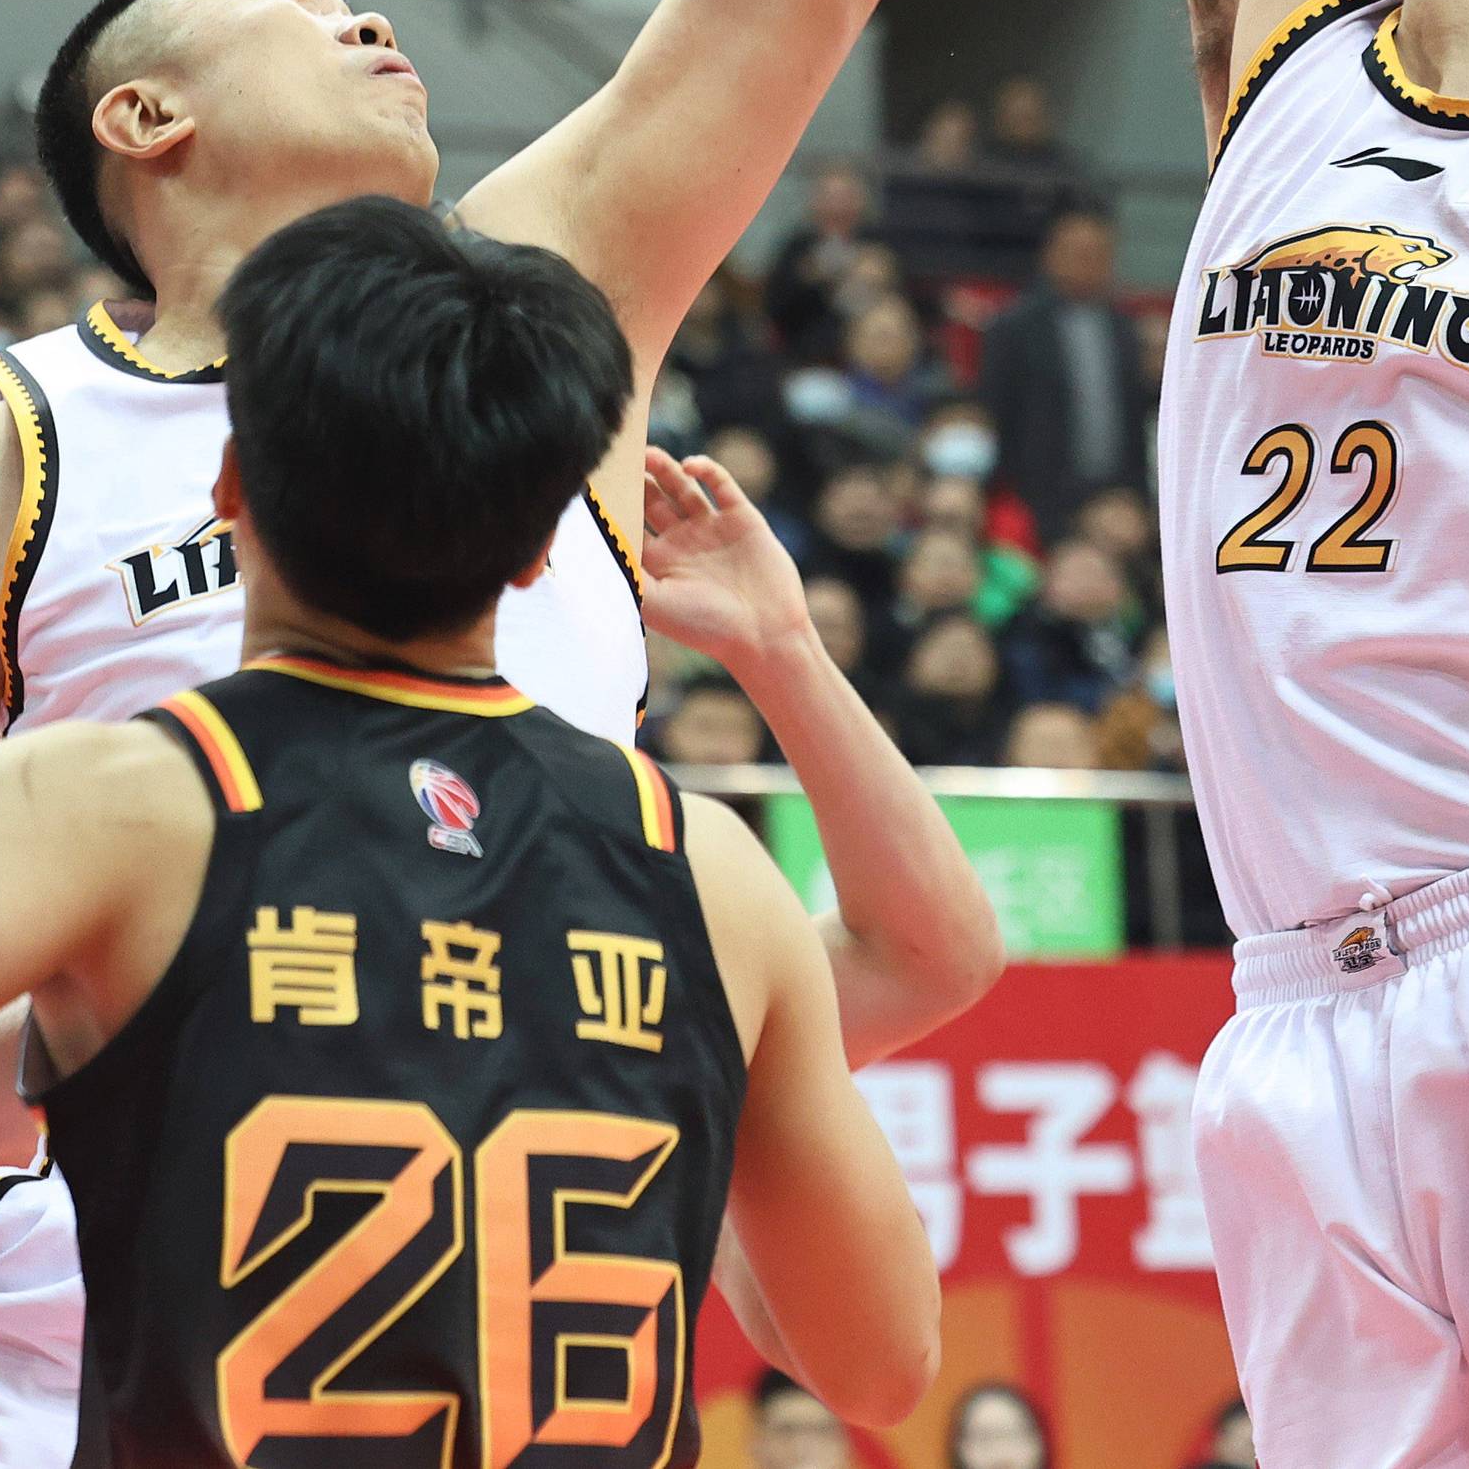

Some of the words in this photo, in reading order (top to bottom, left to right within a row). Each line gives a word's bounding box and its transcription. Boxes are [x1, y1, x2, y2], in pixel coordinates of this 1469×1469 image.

[1264, 331, 1375, 360] LEOPARDS
[1215, 419, 1399, 575] 22
[246, 905, 668, 1054] 肯帝亚
[216, 1093, 687, 1469] 26
